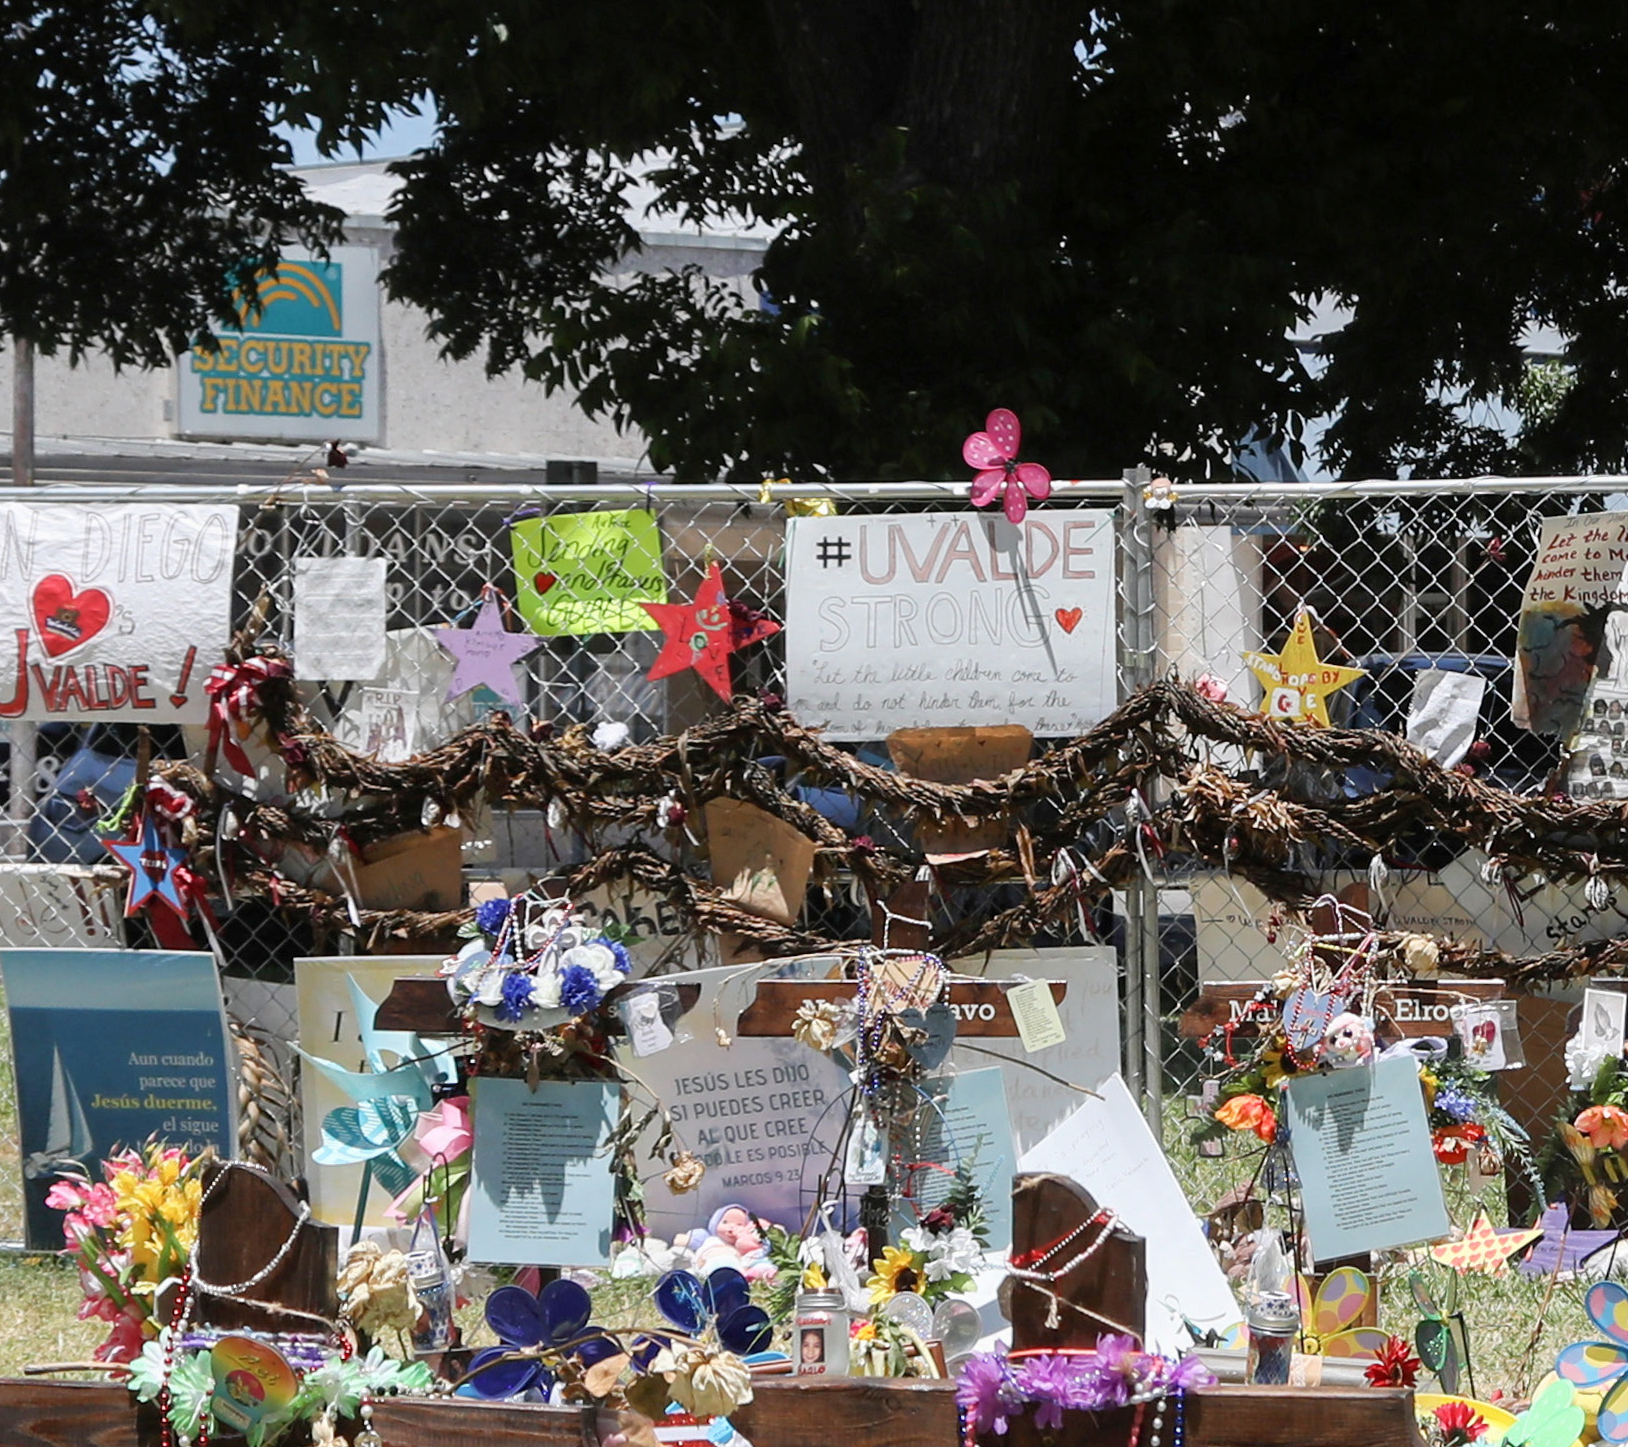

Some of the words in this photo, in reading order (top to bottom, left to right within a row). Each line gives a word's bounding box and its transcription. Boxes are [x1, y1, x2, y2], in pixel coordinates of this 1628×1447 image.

[193, 336, 371, 377] SECURITY
[200, 376, 362, 417] FINANCE
[81, 510, 229, 585] DIEGO
[1547, 533, 1578, 551] Let
[1583, 527, 1610, 544] the
[1542, 550, 1578, 565] come
[1584, 547, 1602, 560] to
[1533, 567, 1577, 582] hinder
[1529, 585, 1557, 602] the
[818, 584, 1053, 653] STRONG
[850, 664, 883, 686] the
[888, 660, 938, 684] little
[944, 657, 1004, 683] children
[1010, 668, 1049, 684] come
[1054, 667, 1079, 683] to
[852, 691, 873, 712] do
[880, 691, 907, 712] not
[918, 689, 962, 711] hinder
[1006, 689, 1035, 715] for
[1041, 688, 1072, 708] the
[127, 1051, 158, 1067] Aun
[160, 1051, 215, 1067] cuando
[138, 1074, 187, 1091] parece
[188, 1076, 217, 1092] que
[674, 1070, 730, 1096] JESÚS
[734, 1068, 768, 1089] LES
[772, 1063, 810, 1085] DIJO
[90, 1093, 141, 1110] Jesús
[143, 1093, 218, 1112] duerme,
[670, 1105, 689, 1122] SI
[693, 1095, 764, 1120] PUEDES
[768, 1088, 826, 1112] CREER
[162, 1115, 177, 1133] el
[179, 1117, 220, 1135] sigue
[698, 1128, 722, 1146] AL
[724, 1122, 760, 1143] QUE
[764, 1116, 809, 1138] CREE
[726, 1152, 744, 1165] LE
[747, 1148, 765, 1162] ES
[768, 1140, 826, 1160] POSIBLE
[722, 1171, 772, 1188] MARCOS
